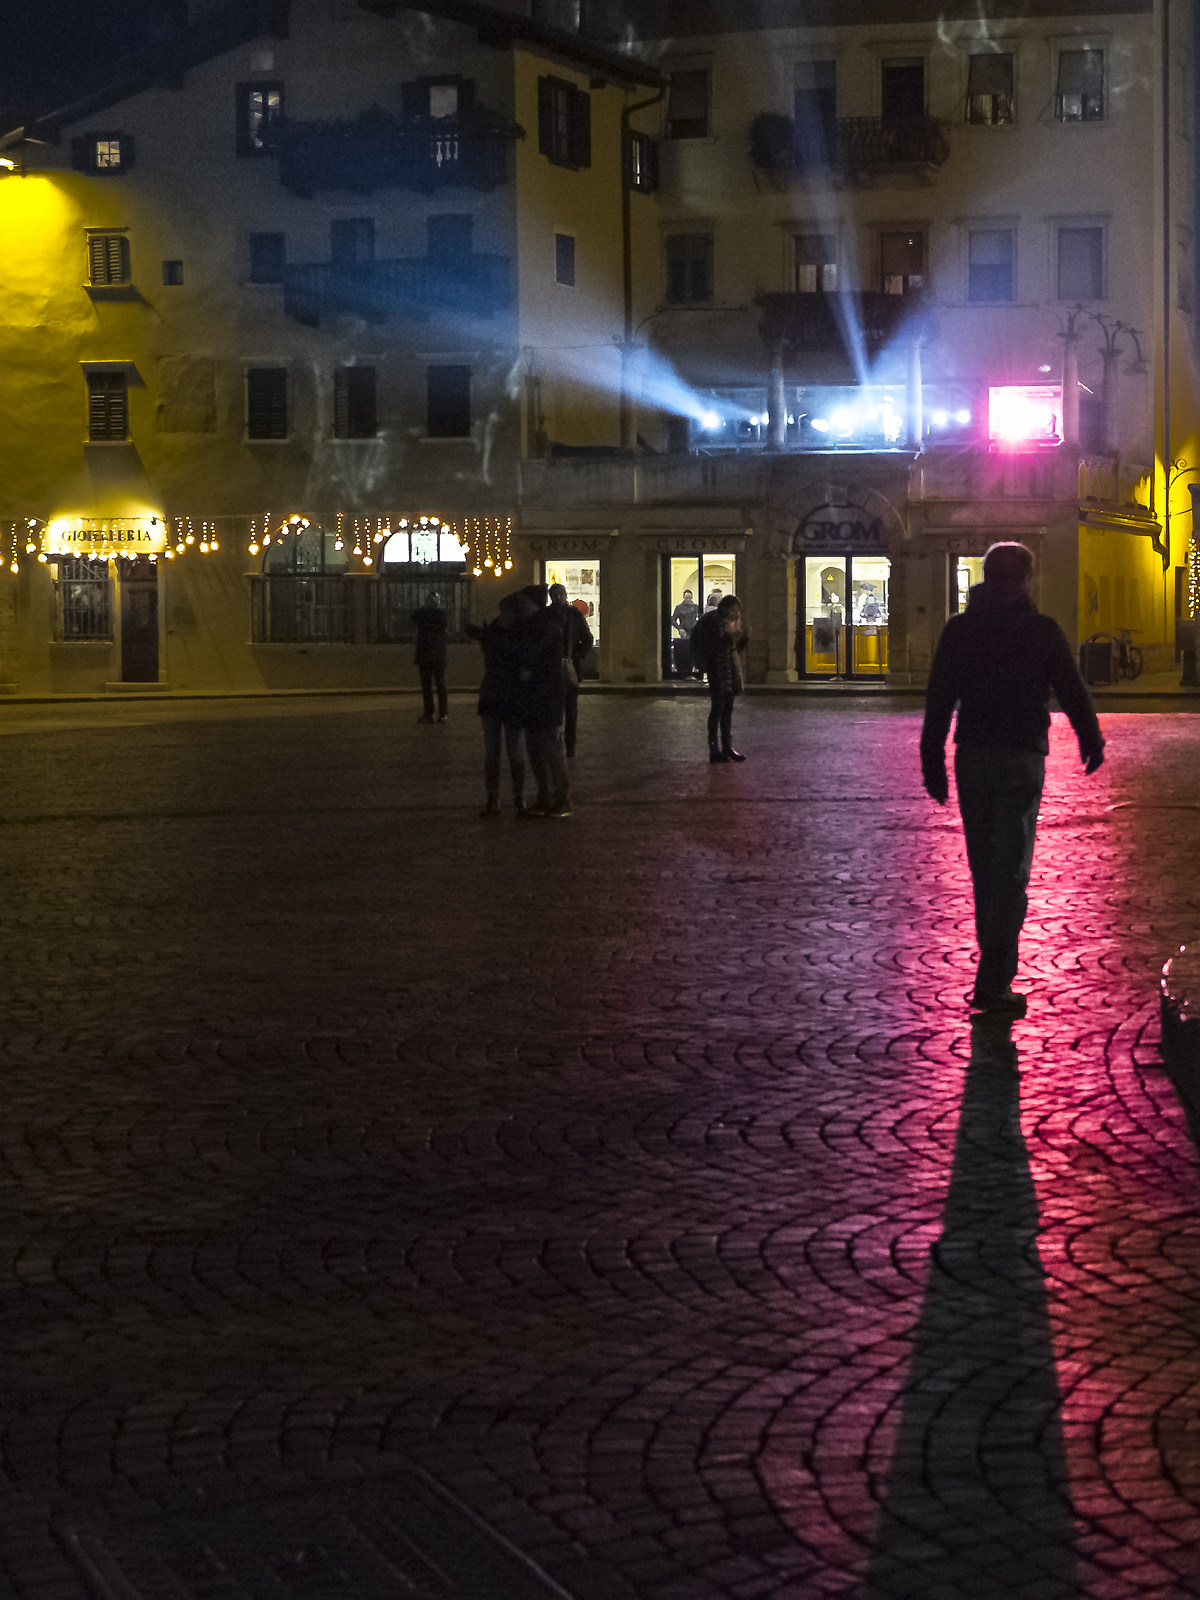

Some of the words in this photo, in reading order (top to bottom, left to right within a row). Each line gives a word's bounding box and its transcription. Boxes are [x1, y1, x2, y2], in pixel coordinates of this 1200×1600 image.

[800, 520, 882, 541] GROM
[529, 539, 598, 552] GROM
[656, 538, 728, 551] GROM
